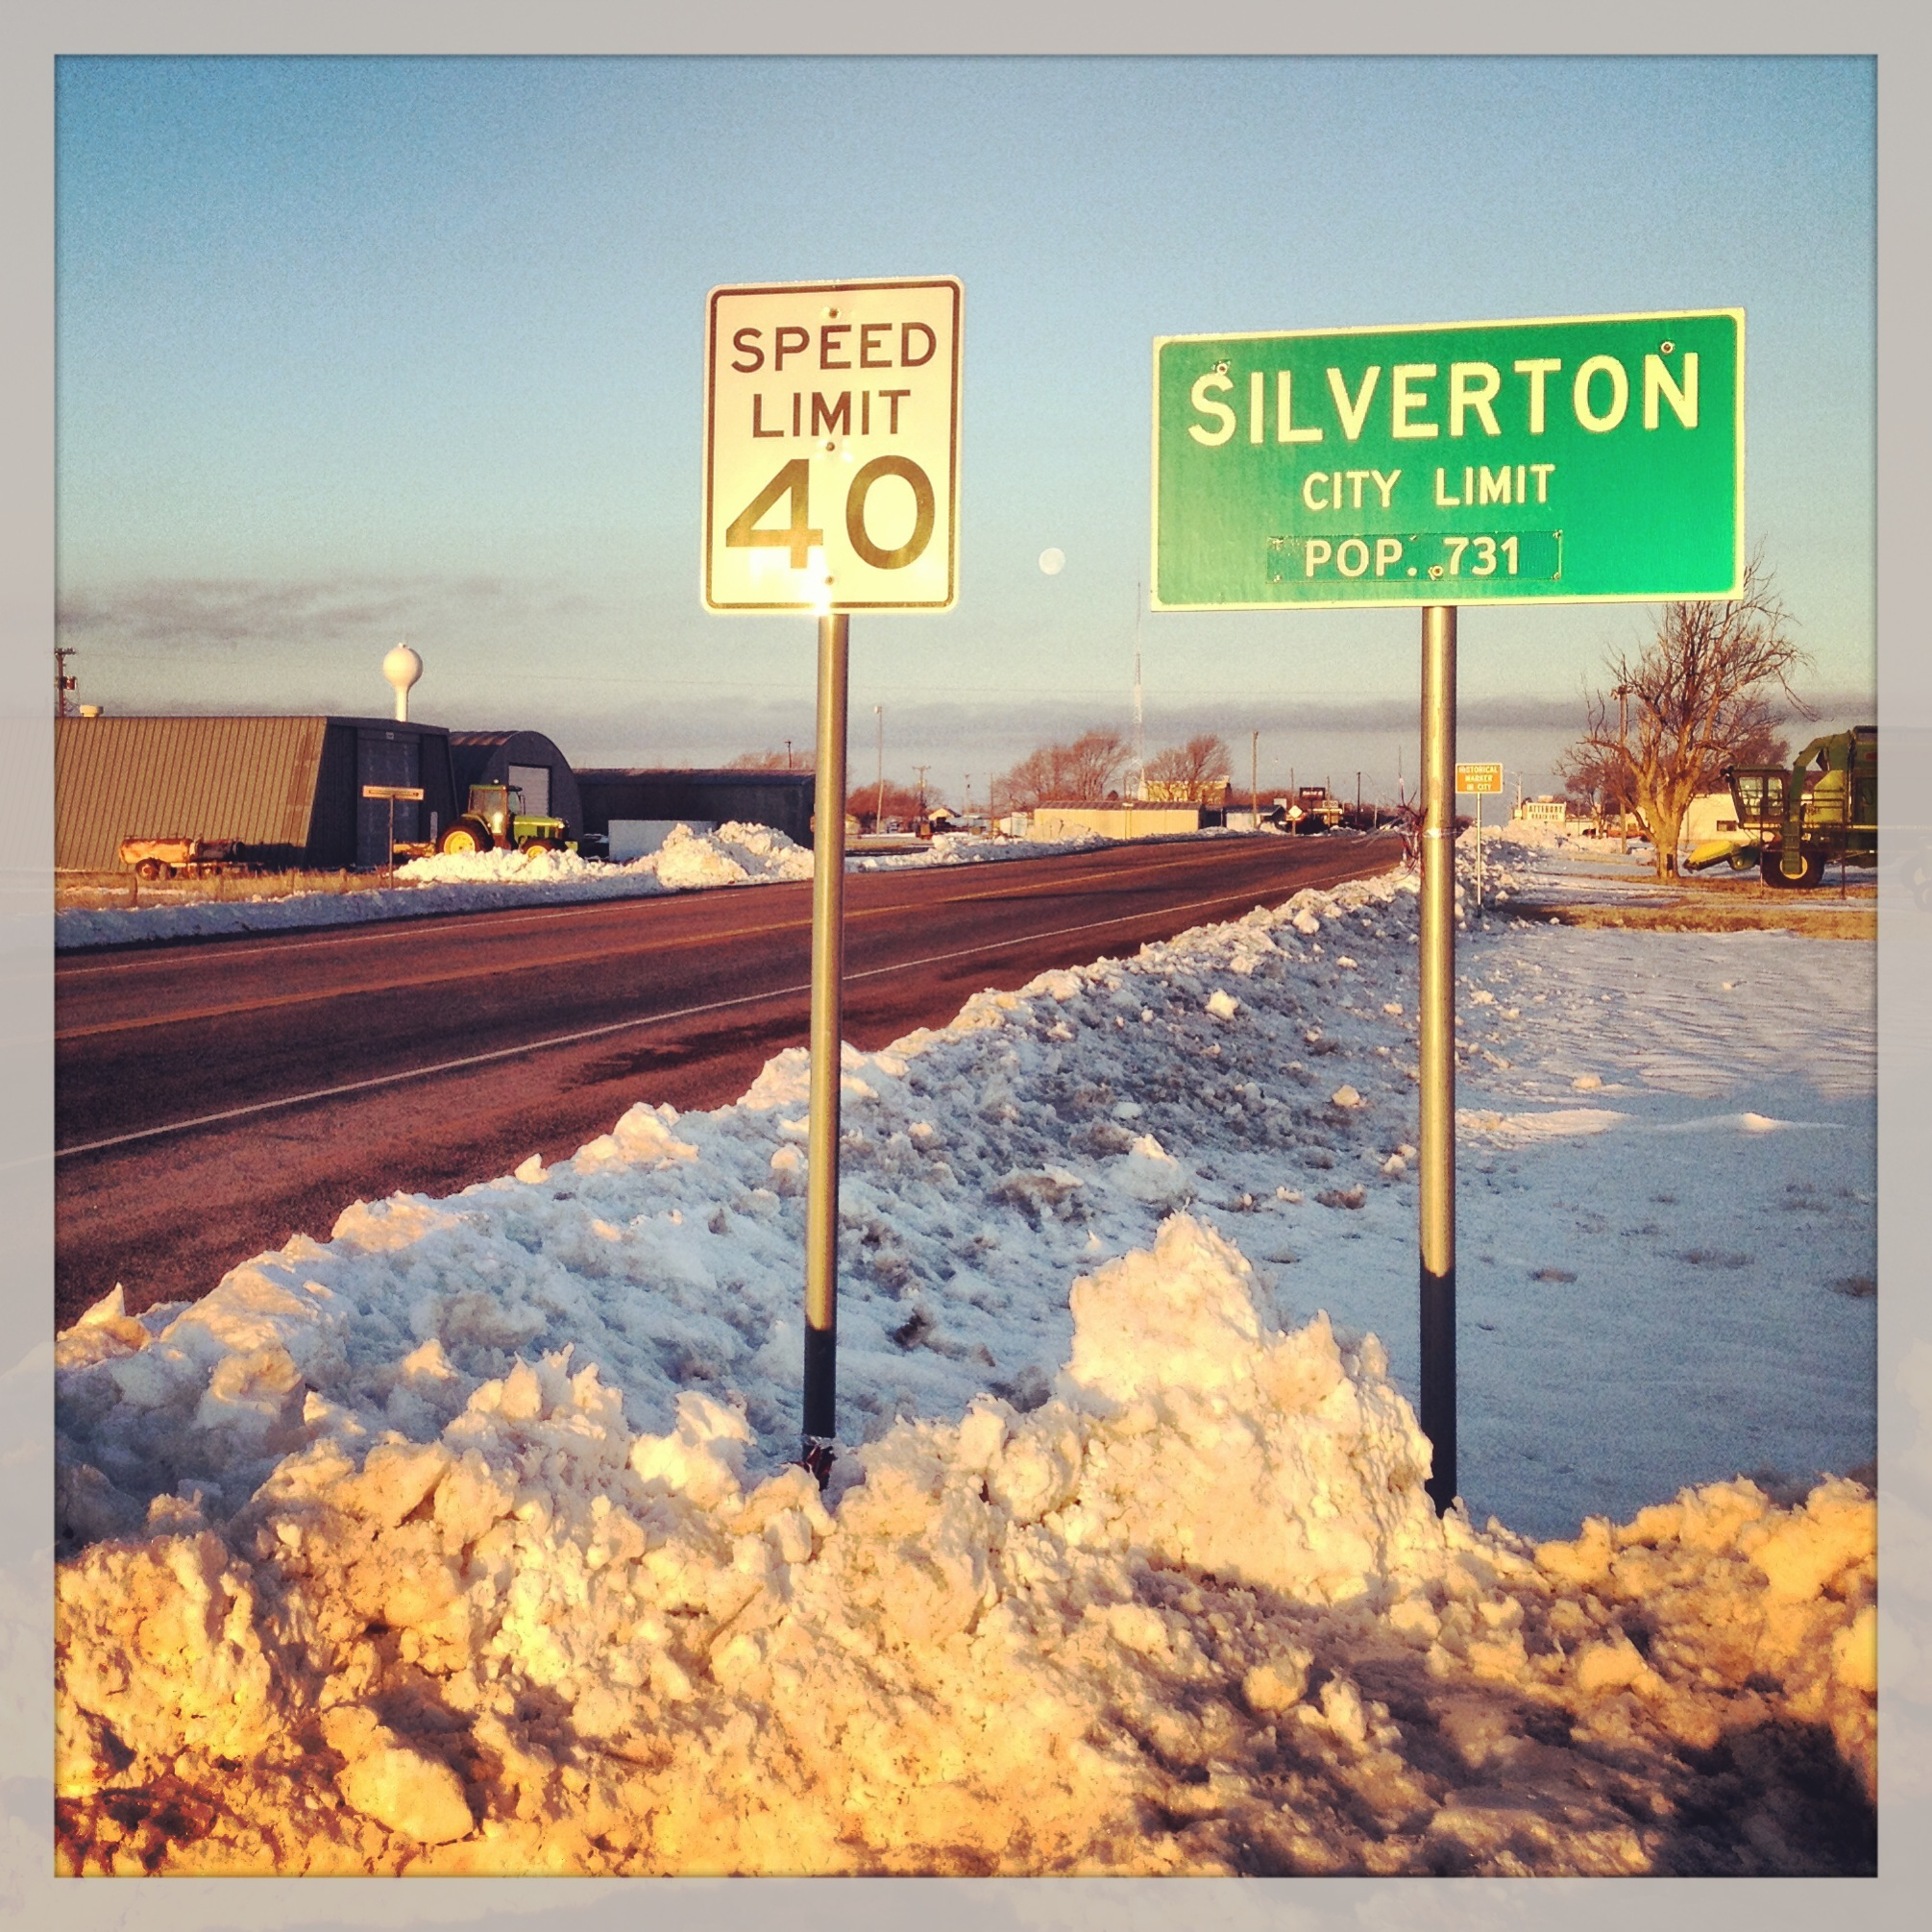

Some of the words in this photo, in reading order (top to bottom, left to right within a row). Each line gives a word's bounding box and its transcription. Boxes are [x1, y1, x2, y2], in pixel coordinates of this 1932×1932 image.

[730, 321, 938, 374] SPEED
[752, 389, 912, 438] LIMIT
[1187, 351, 1700, 447] SILVERTON
[725, 454, 936, 570] 40
[1303, 469, 1403, 511] CITY
[1435, 463, 1556, 506] LIMIT
[1305, 538, 1418, 577] POP.
[1443, 536, 1519, 576] 731
